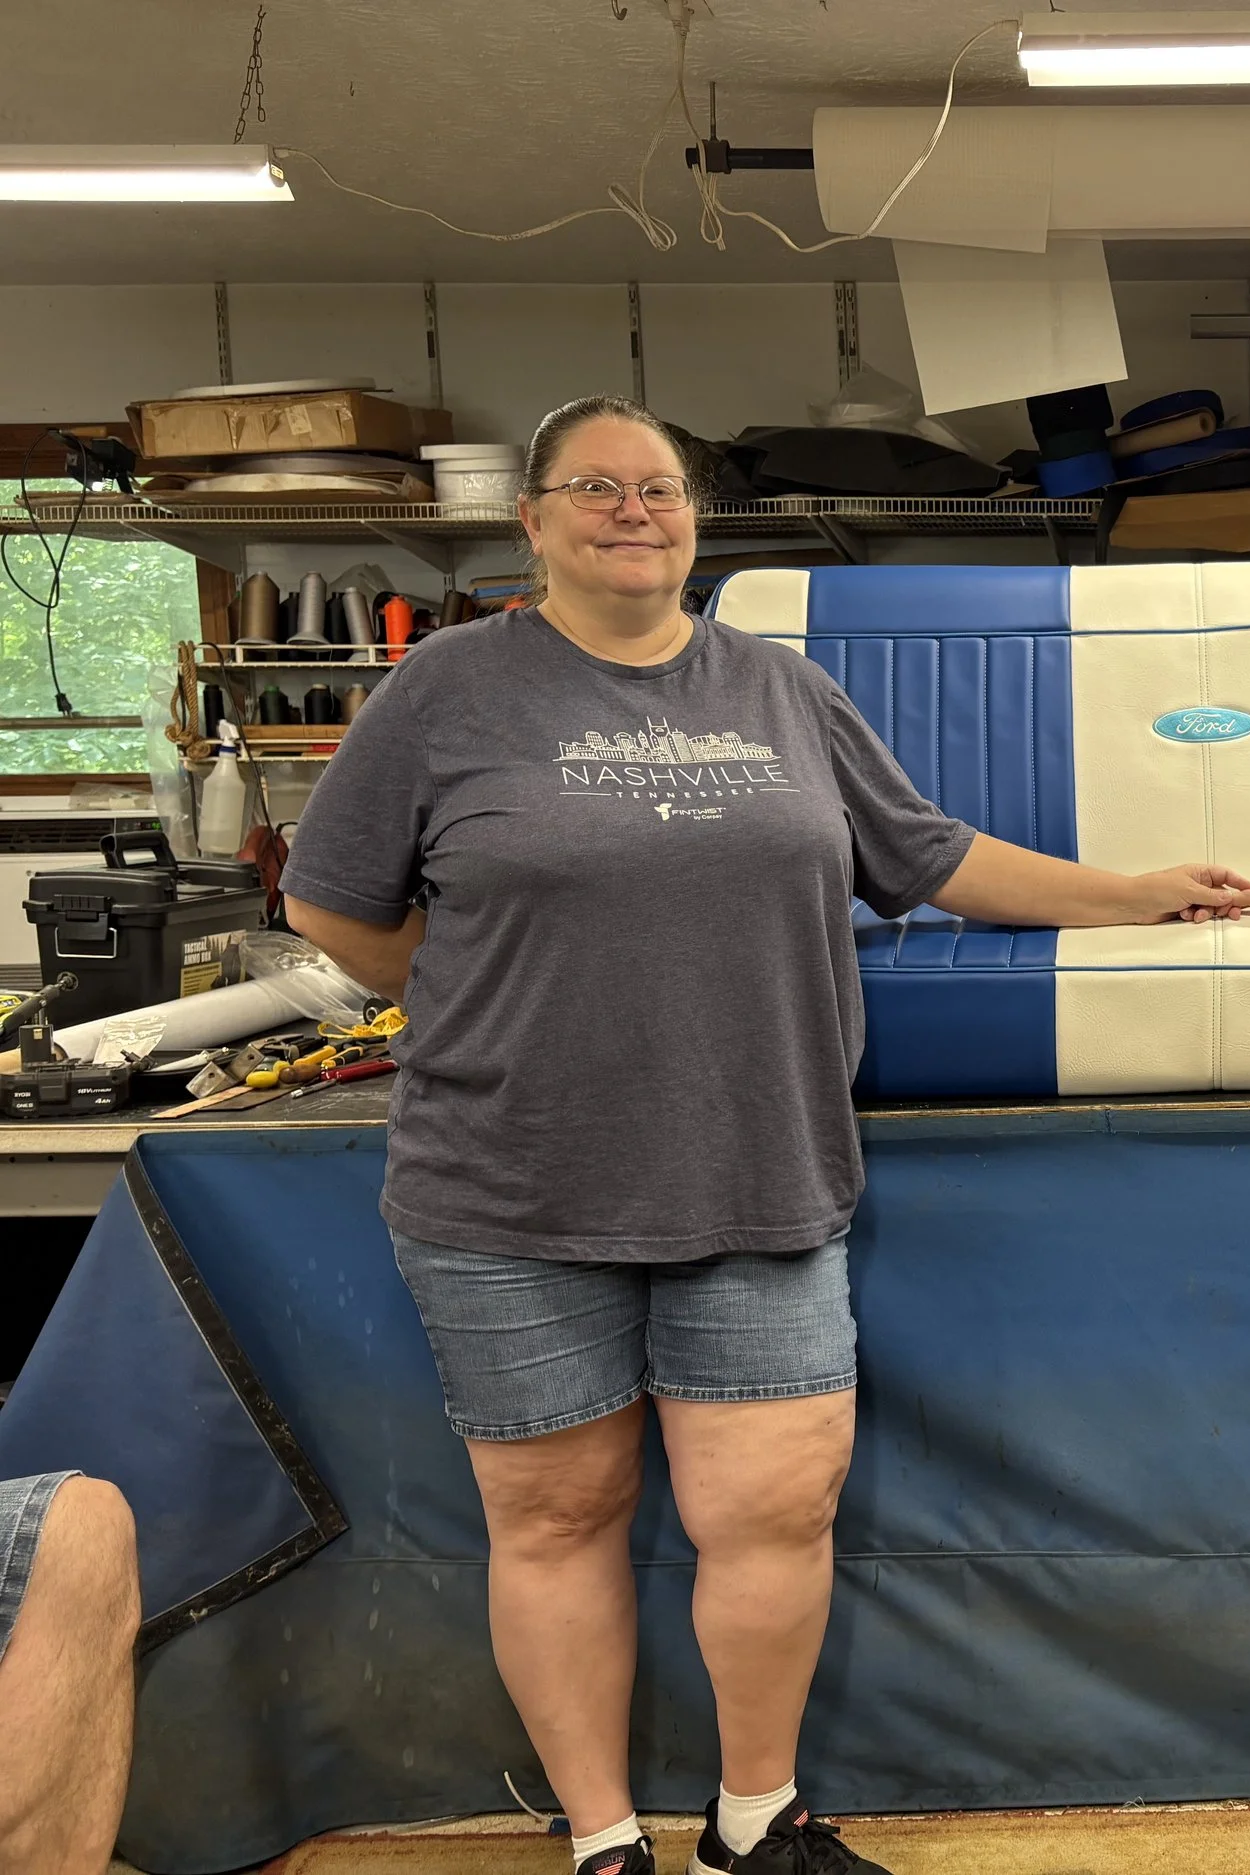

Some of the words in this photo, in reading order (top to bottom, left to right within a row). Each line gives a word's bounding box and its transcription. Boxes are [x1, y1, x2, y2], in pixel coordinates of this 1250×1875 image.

[1176, 712, 1236, 734] Ford
[561, 764, 789, 787] NASHVILLE
[616, 787, 755, 799] TENNESSEE
[671, 807, 724, 816] FINTWIST
[184, 939, 207, 955] TACTICAL
[184, 953, 200, 966] AMMO
[201, 951, 212, 963] BOX
